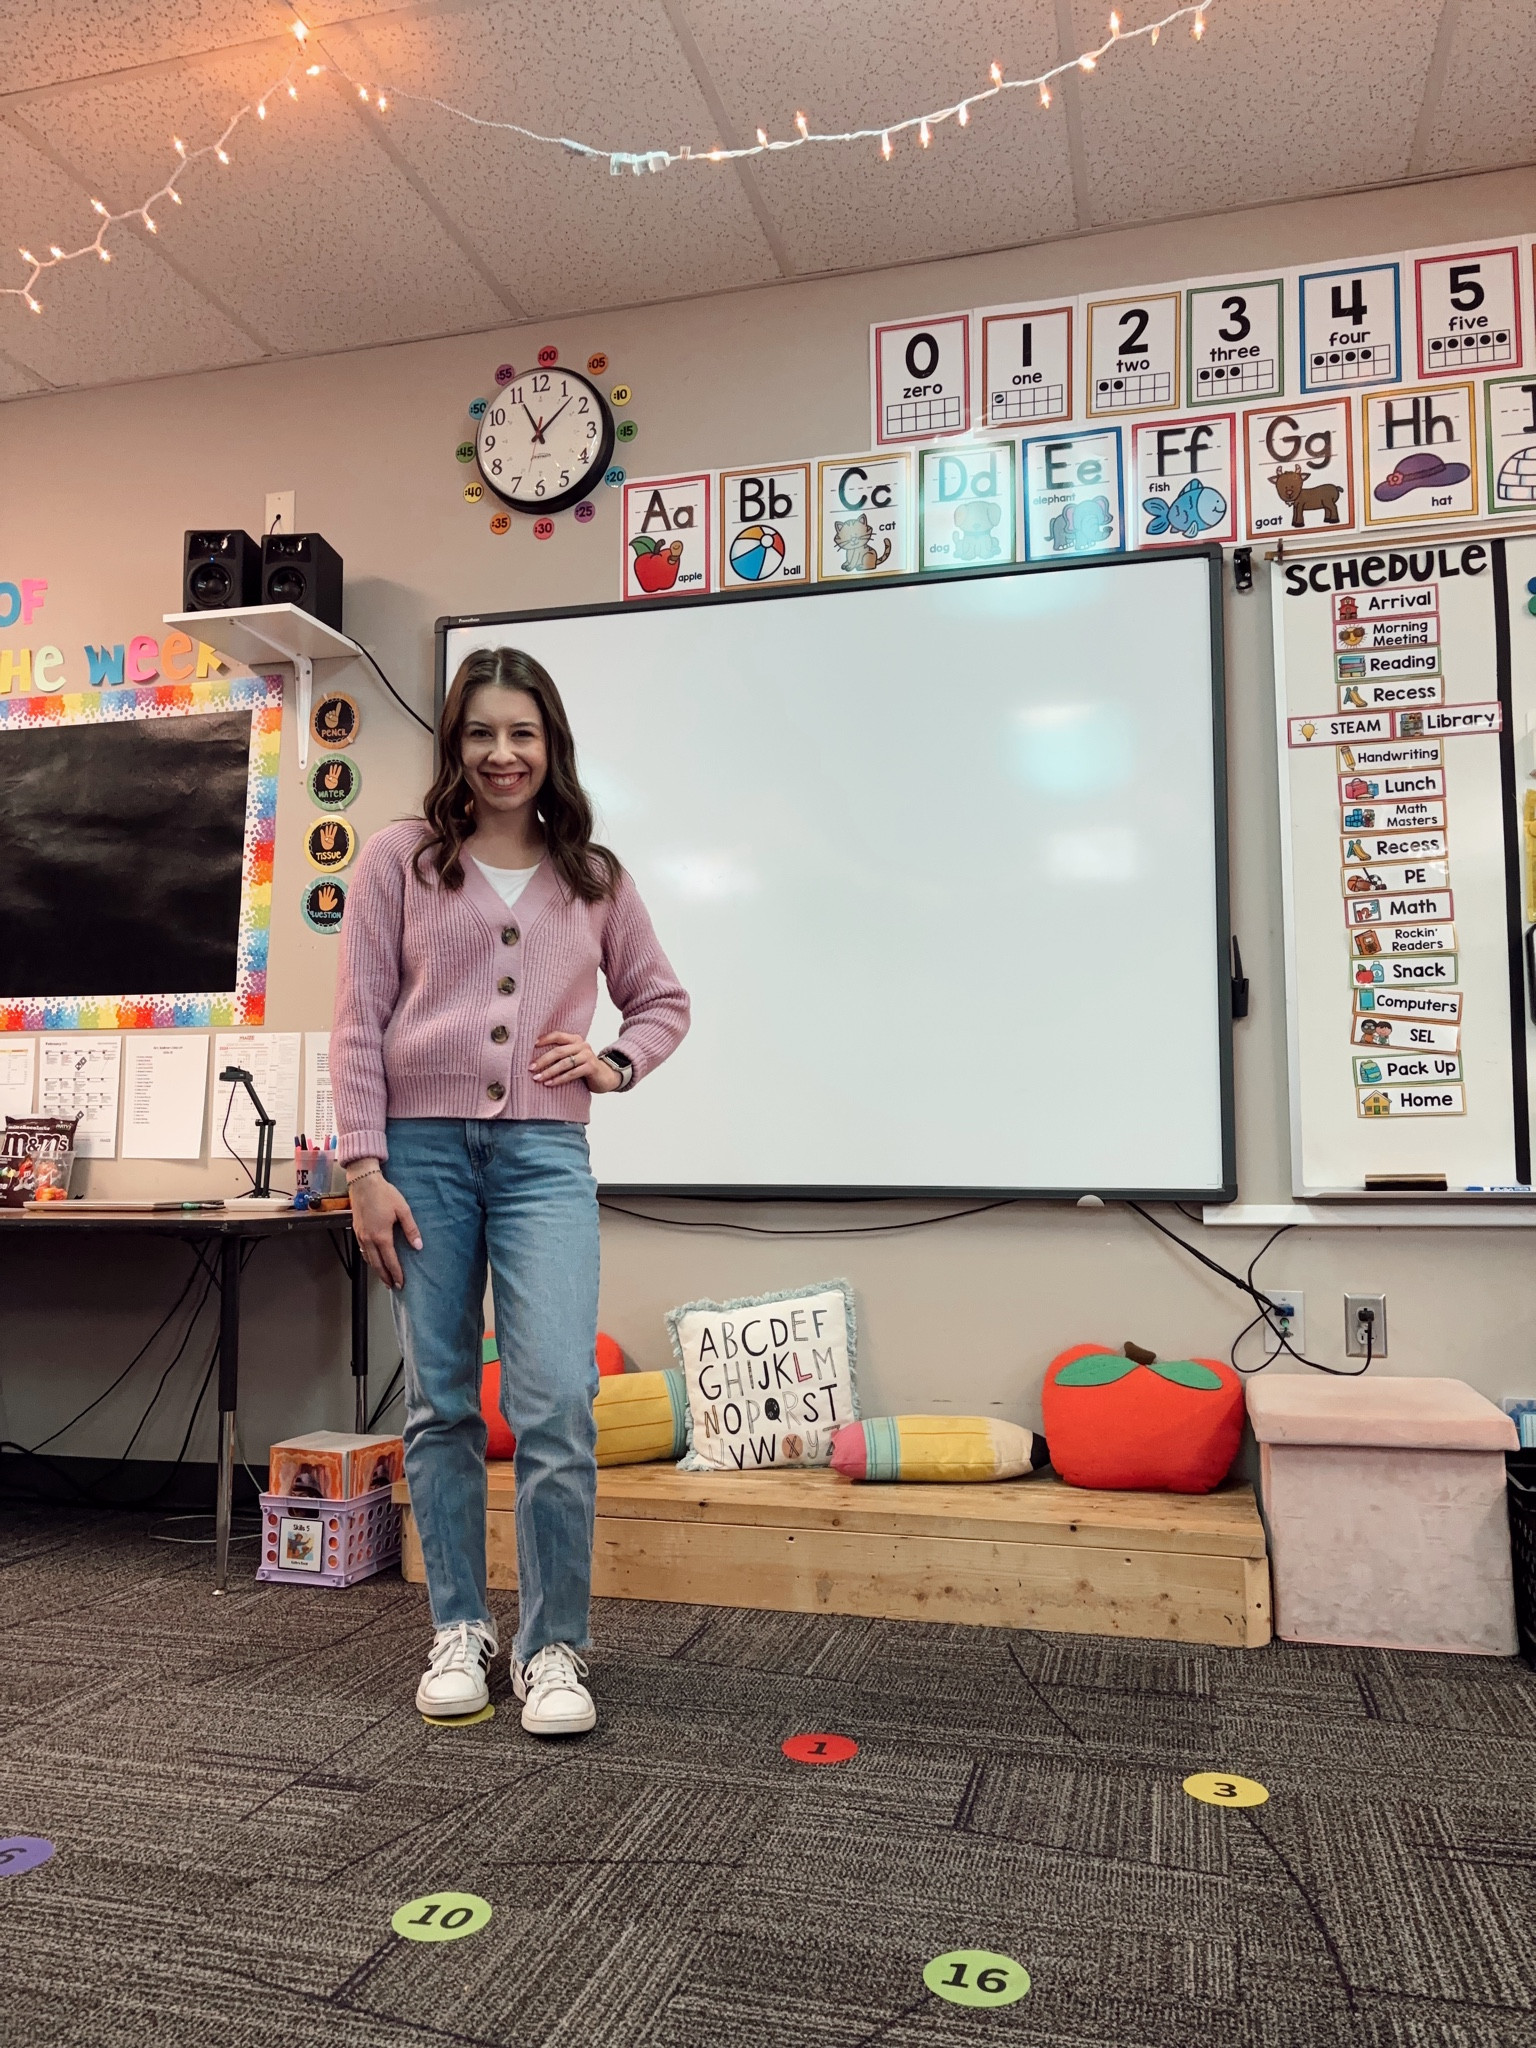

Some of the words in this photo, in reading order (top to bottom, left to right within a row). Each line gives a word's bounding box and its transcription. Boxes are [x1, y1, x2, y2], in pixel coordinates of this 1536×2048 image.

[1449, 264, 1485, 312] 5
[1331, 279, 1367, 326] 4
[1218, 296, 1251, 342] 3
[1448, 315, 1488, 332] five
[1118, 308, 1149, 356] 2
[1329, 330, 1371, 347] four
[1022, 323, 1032, 367] 1
[1209, 345, 1260, 362] three
[538, 350, 556, 362] :00
[589, 357, 606, 369] :05
[905, 332, 939, 379] 0
[1116, 358, 1150, 373] two
[531, 374, 551, 393] 12
[1012, 370, 1042, 386] one
[511, 387, 524, 405] 11
[561, 380, 569, 397] 1
[614, 389, 627, 400] :10
[903, 382, 943, 400] zero
[578, 397, 589, 414] 2
[489, 408, 506, 426] 10
[1385, 395, 1454, 450] Hh
[586, 421, 596, 438] 3
[485, 436, 496, 453] 9
[1157, 425, 1214, 477] Ff
[1265, 415, 1332, 470] Gg
[578, 448, 589, 464] 4
[492, 459, 502, 475] 8
[1044, 443, 1102, 490] Ee
[559, 470, 569, 487] 5
[606, 471, 624, 483] :20
[938, 451, 997, 501] Dd
[464, 487, 482, 498] :40
[511, 476, 522, 494] 7
[535, 479, 545, 496] 6
[838, 466, 892, 511] Cc
[1149, 482, 1170, 493] fish
[739, 477, 793, 523] Bb
[1032, 493, 1076, 506] elephant
[1431, 495, 1452, 507] hat
[641, 489, 694, 533] Aa
[491, 518, 508, 529] :35
[534, 522, 552, 534] :30
[878, 521, 896, 532] cat
[1255, 516, 1283, 530] goat
[929, 543, 950, 554] dog
[678, 571, 703, 583] apple
[783, 565, 801, 576] ball
[1368, 591, 1431, 611] Arrival
[1373, 621, 1428, 635] Morning
[1373, 633, 1428, 647] Meeting
[1370, 654, 1436, 672] Reading
[1373, 685, 1436, 702] Recess
[1330, 719, 1381, 735] STEAM
[1427, 712, 1495, 729] Library
[1358, 748, 1438, 763] Handwriting
[1385, 776, 1436, 793] Lunch
[1396, 804, 1427, 814] Math
[1387, 816, 1438, 827] Masters
[1376, 839, 1440, 855] Recess
[1404, 868, 1426, 884] PE
[1390, 899, 1437, 916] Math
[1395, 928, 1438, 939] Rockin'
[1392, 939, 1444, 952] Readers
[1393, 962, 1446, 979] Snack
[1377, 995, 1457, 1013] Computers
[1410, 1029, 1435, 1043] SEL
[1387, 1060, 1429, 1077] Pack
[1434, 1060, 1456, 1076] Up
[1400, 1092, 1453, 1108] Home
[807, 1742, 827, 1755] 1
[1213, 1782, 1237, 1797] 3
[408, 1905, 473, 1929] 10
[941, 1963, 1010, 1993] 16
